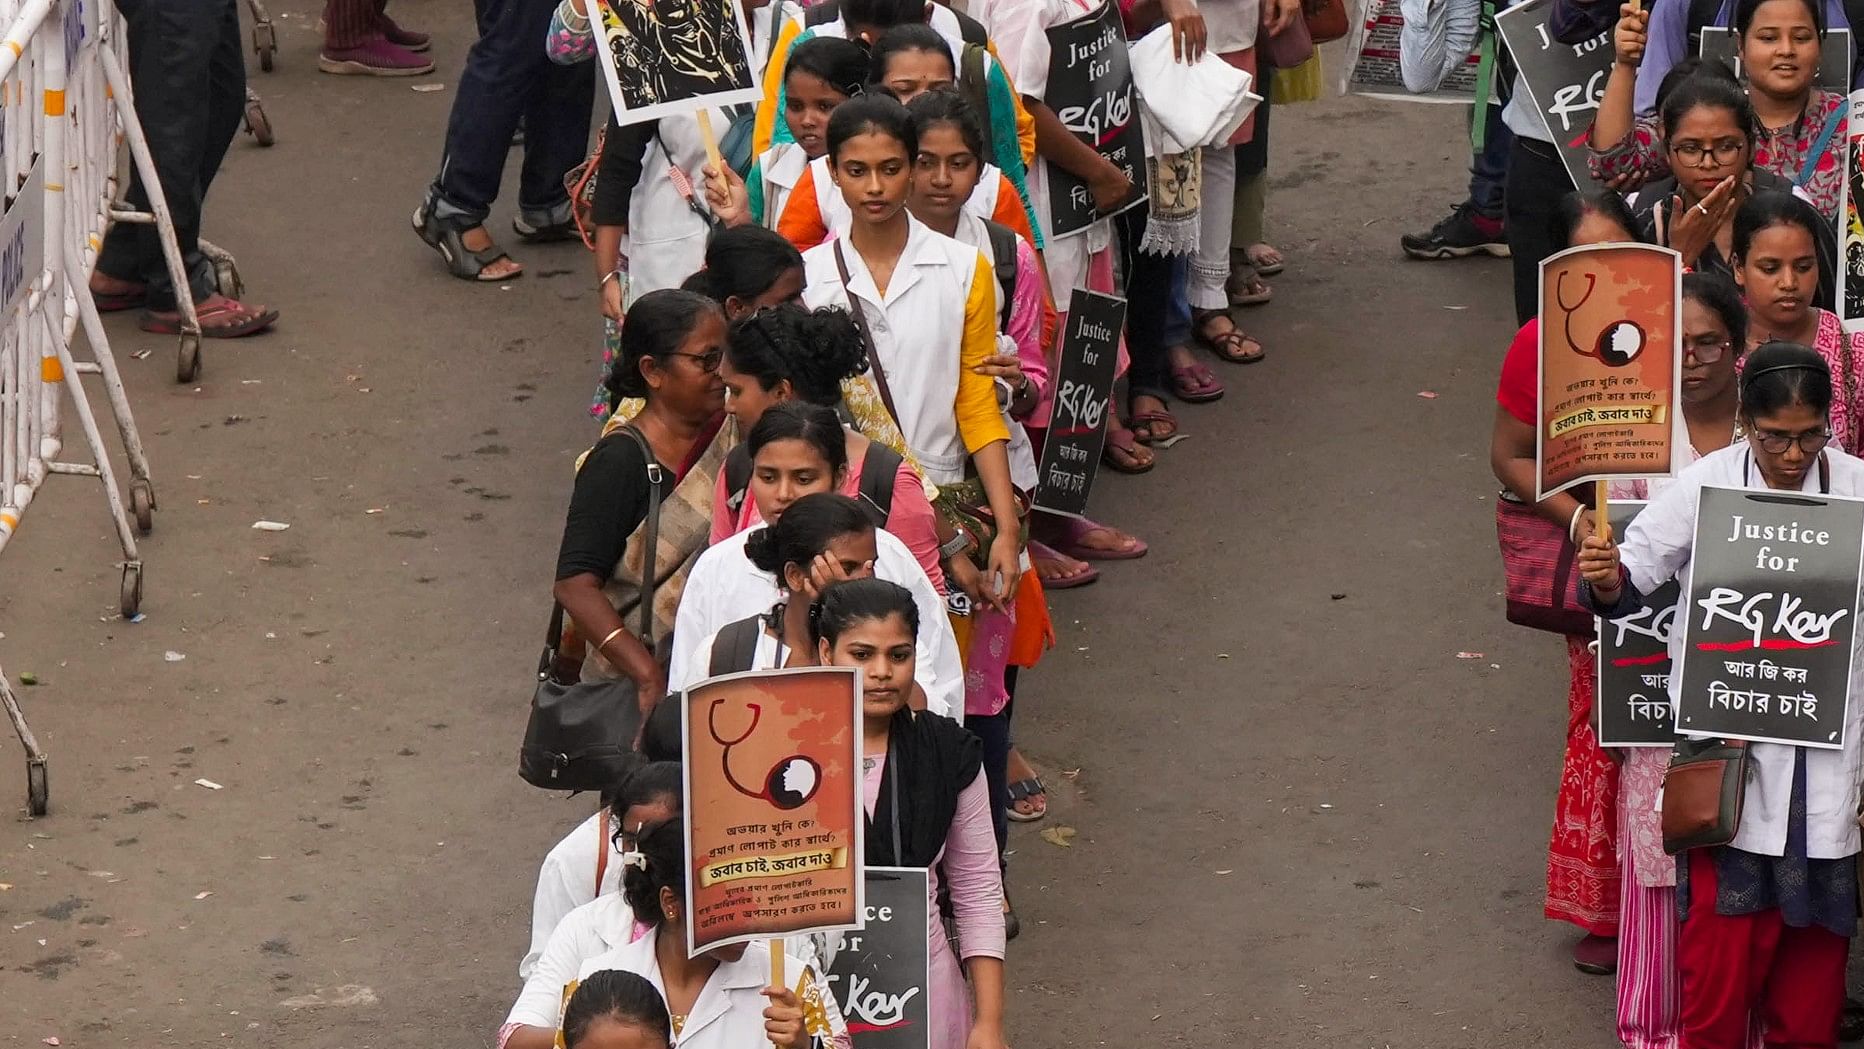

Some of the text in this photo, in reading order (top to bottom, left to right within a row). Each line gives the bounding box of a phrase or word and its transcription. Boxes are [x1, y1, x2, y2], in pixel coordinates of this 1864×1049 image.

[1067, 25, 1118, 68] Justice
[1088, 58, 1111, 82] for
[1074, 315, 1111, 343] Justice
[1082, 343, 1100, 366] for
[1047, 462, 1086, 496] বিচার চাই
[1727, 515, 1830, 545] Justice
[1755, 546, 1799, 573] for
[1697, 585, 1773, 648] RG
[1772, 592, 1848, 644] Kar
[1723, 658, 1807, 684] আর জি কর
[1707, 680, 1770, 713] বিচার
[1777, 689, 1818, 721] চাই
[710, 862, 743, 879] জবাব
[744, 857, 770, 873] চাই,
[772, 856, 806, 871] জবাব
